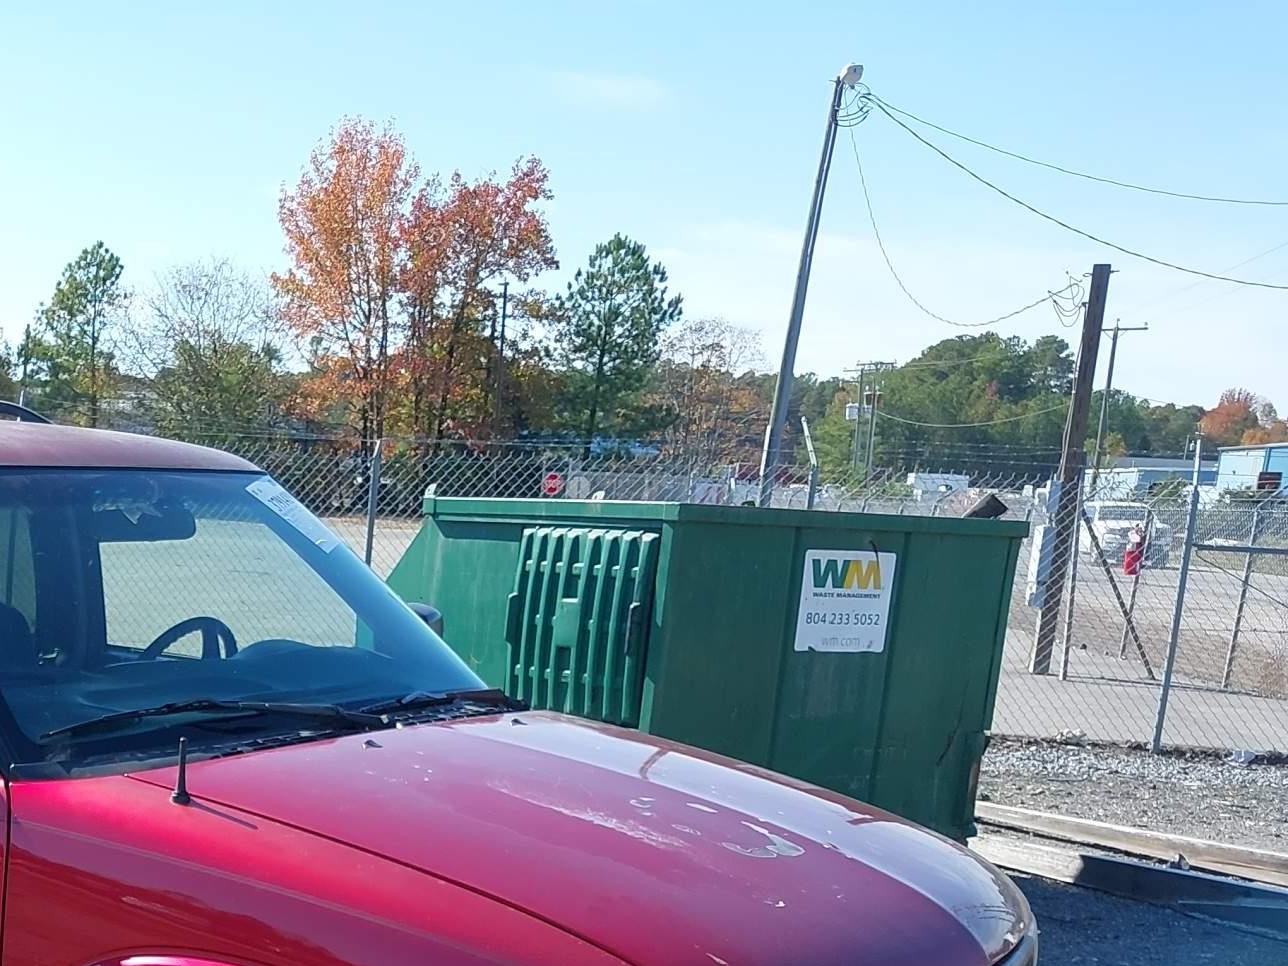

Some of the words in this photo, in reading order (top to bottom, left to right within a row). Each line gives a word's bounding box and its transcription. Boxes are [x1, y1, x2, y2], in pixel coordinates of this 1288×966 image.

[812, 559, 881, 590] WM
[806, 612, 827, 625] 804
[829, 612, 851, 625] 233
[854, 613, 880, 626] 5052
